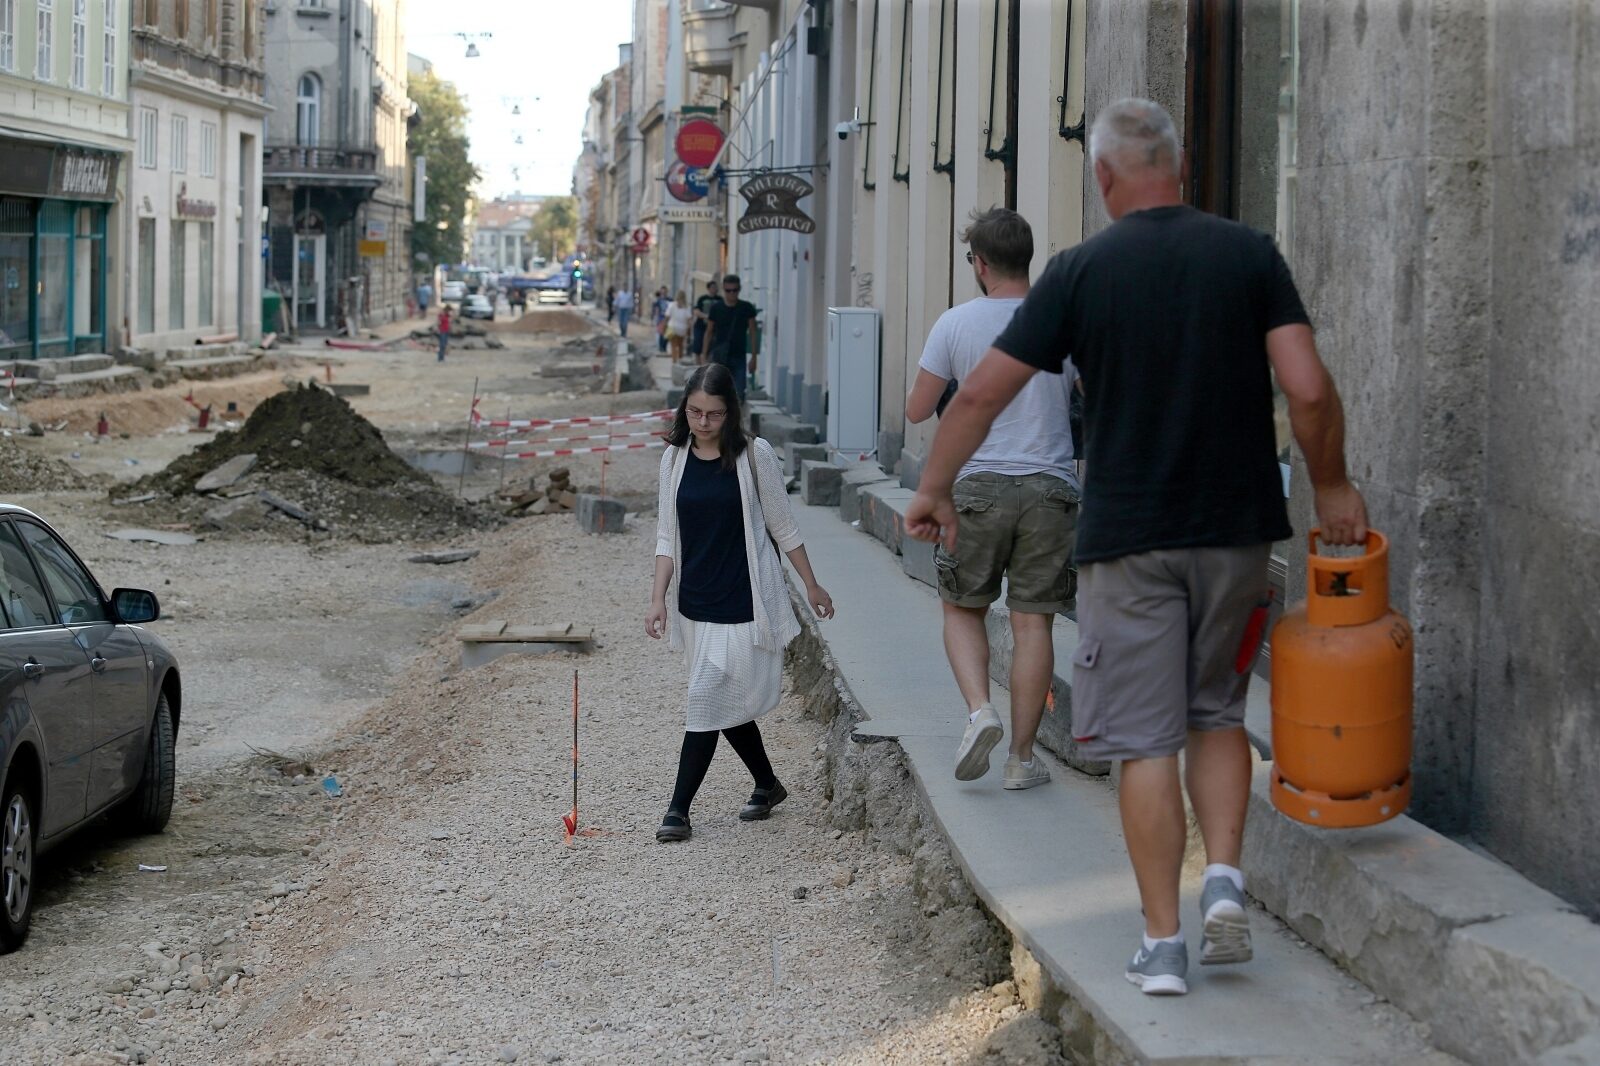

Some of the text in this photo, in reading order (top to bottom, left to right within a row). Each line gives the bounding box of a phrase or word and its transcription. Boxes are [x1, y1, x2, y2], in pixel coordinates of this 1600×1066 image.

[743, 175, 808, 198] NATURA
[671, 209, 713, 218] ALCATRAZ
[739, 215, 812, 232] CROATICA
